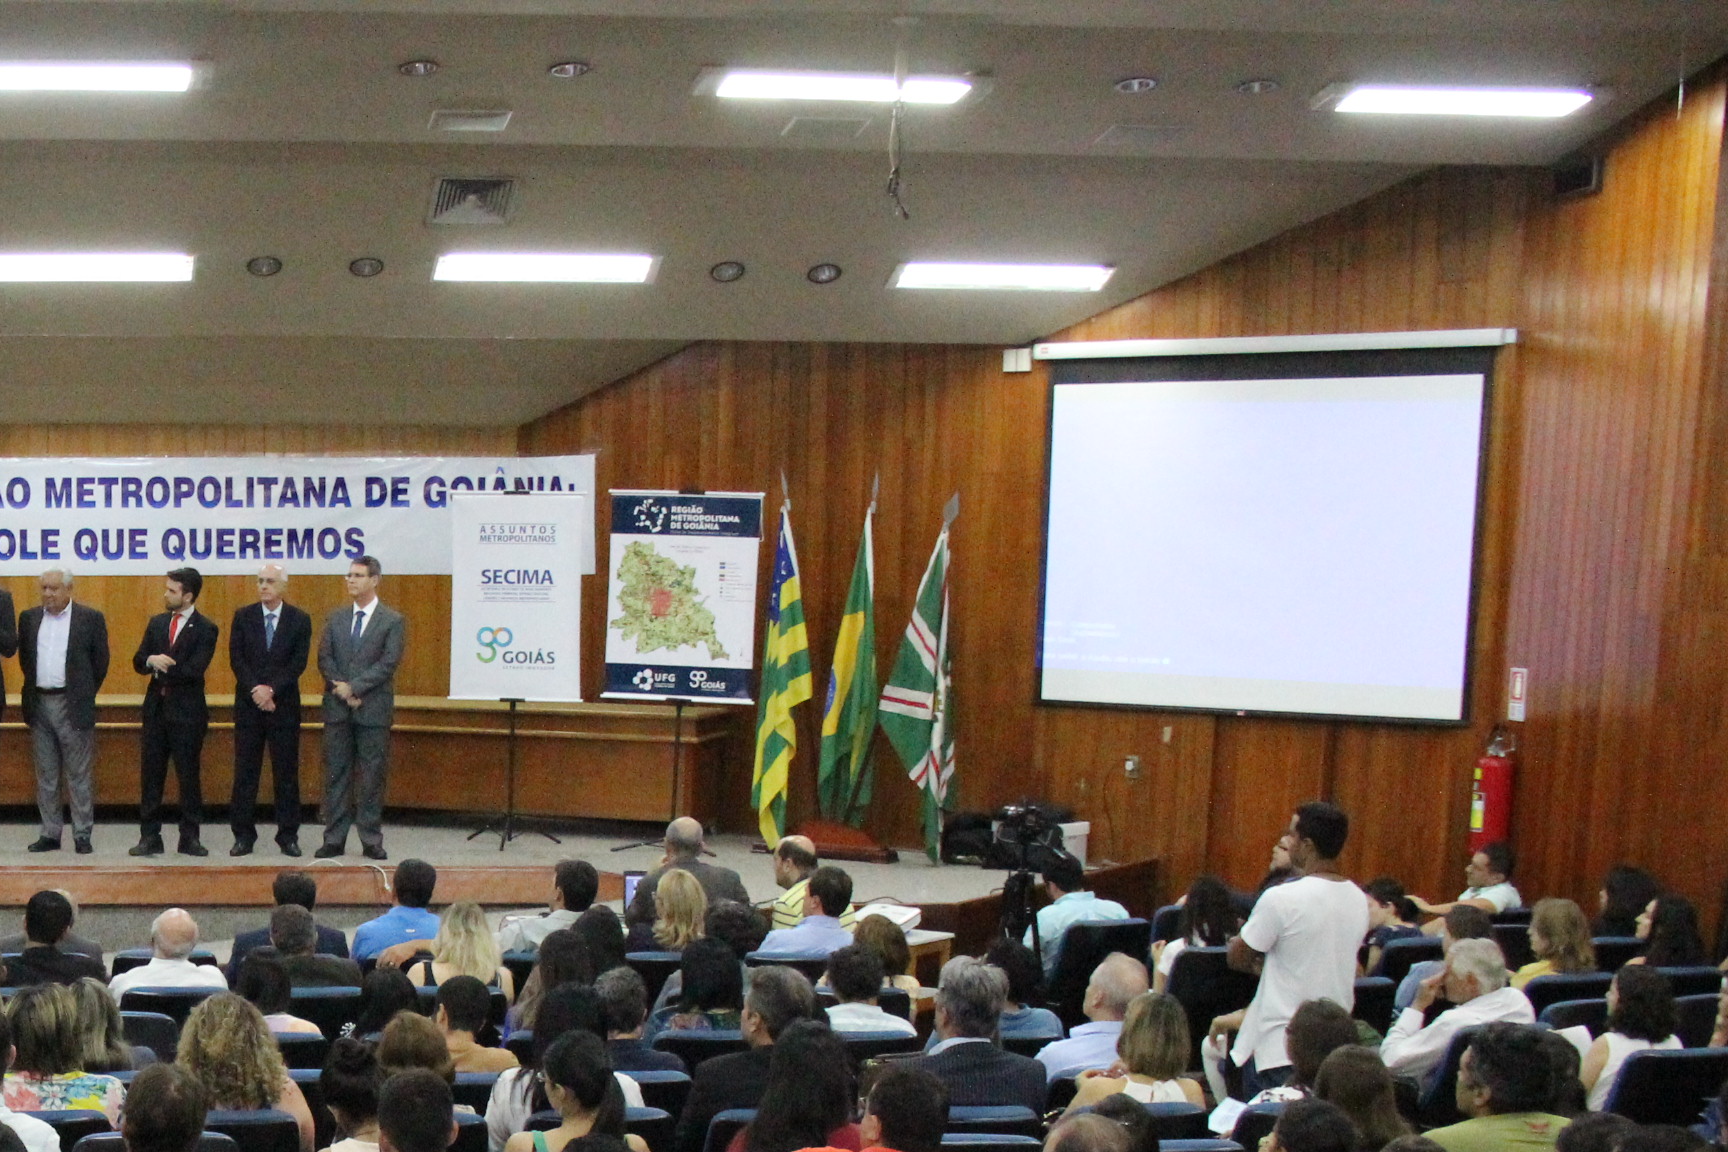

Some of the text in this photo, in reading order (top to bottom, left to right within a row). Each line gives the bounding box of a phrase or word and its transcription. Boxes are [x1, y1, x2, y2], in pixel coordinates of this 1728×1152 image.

[45, 475, 353, 509] METROPOLITANA
[365, 476, 411, 508] DE
[670, 504, 704, 513] REGIÃO
[670, 514, 740, 523] METROPOLITANA
[479, 525, 556, 534] ASSUNTOS
[670, 521, 720, 530] DE GOIÂNIA
[479, 534, 556, 543] METROPOLITANOS
[74, 528, 149, 562] QUE
[161, 527, 366, 562] QUEREMOS
[480, 569, 554, 585] SECIMA
[502, 648, 555, 664] GOIÁS
[654, 673, 676, 682] UFG
